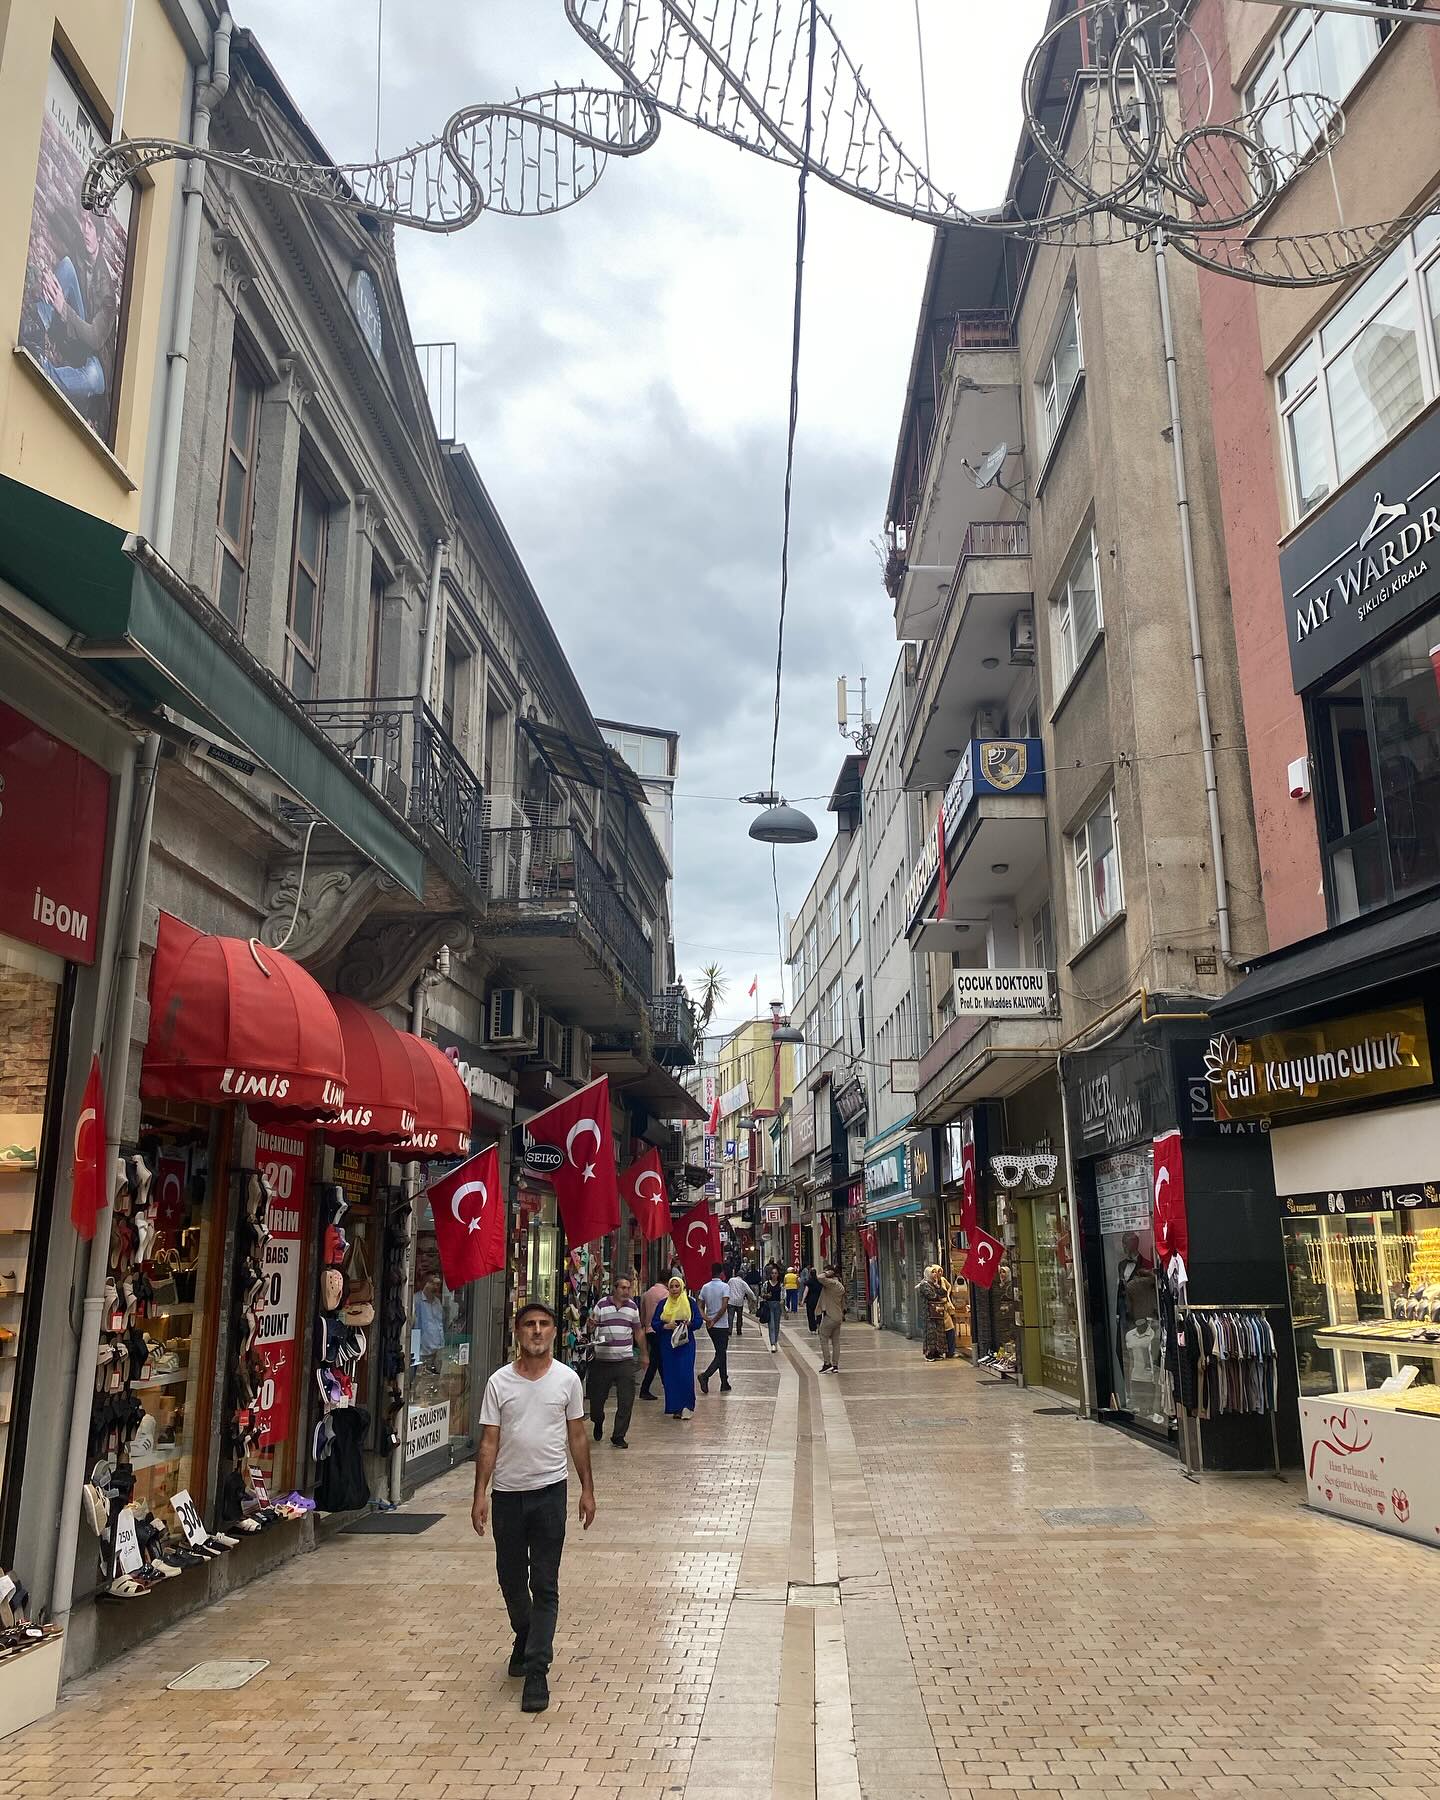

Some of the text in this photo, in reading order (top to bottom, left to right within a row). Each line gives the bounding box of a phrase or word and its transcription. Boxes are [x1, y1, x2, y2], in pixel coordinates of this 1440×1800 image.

[1357, 560, 1428, 622] ŞIKLIĞI KİRALA
[1297, 589, 1332, 643] MY
[33, 886, 88, 941] İBOM
[958, 975, 1043, 994] ÇOCUK DOKTORU
[960, 996, 1045, 1009] Prof. Dr. Mukaddes KALYONCU
[1226, 1032, 1402, 1099] Gül Kuyumculuk
[526, 1152, 561, 1165] SEIKO
[266, 1246, 289, 1264] BAGS
[409, 1405, 448, 1433] VE SOLÜSYON
[416, 1429, 441, 1452] NOKTASI
[175, 1500, 203, 1539] 300
